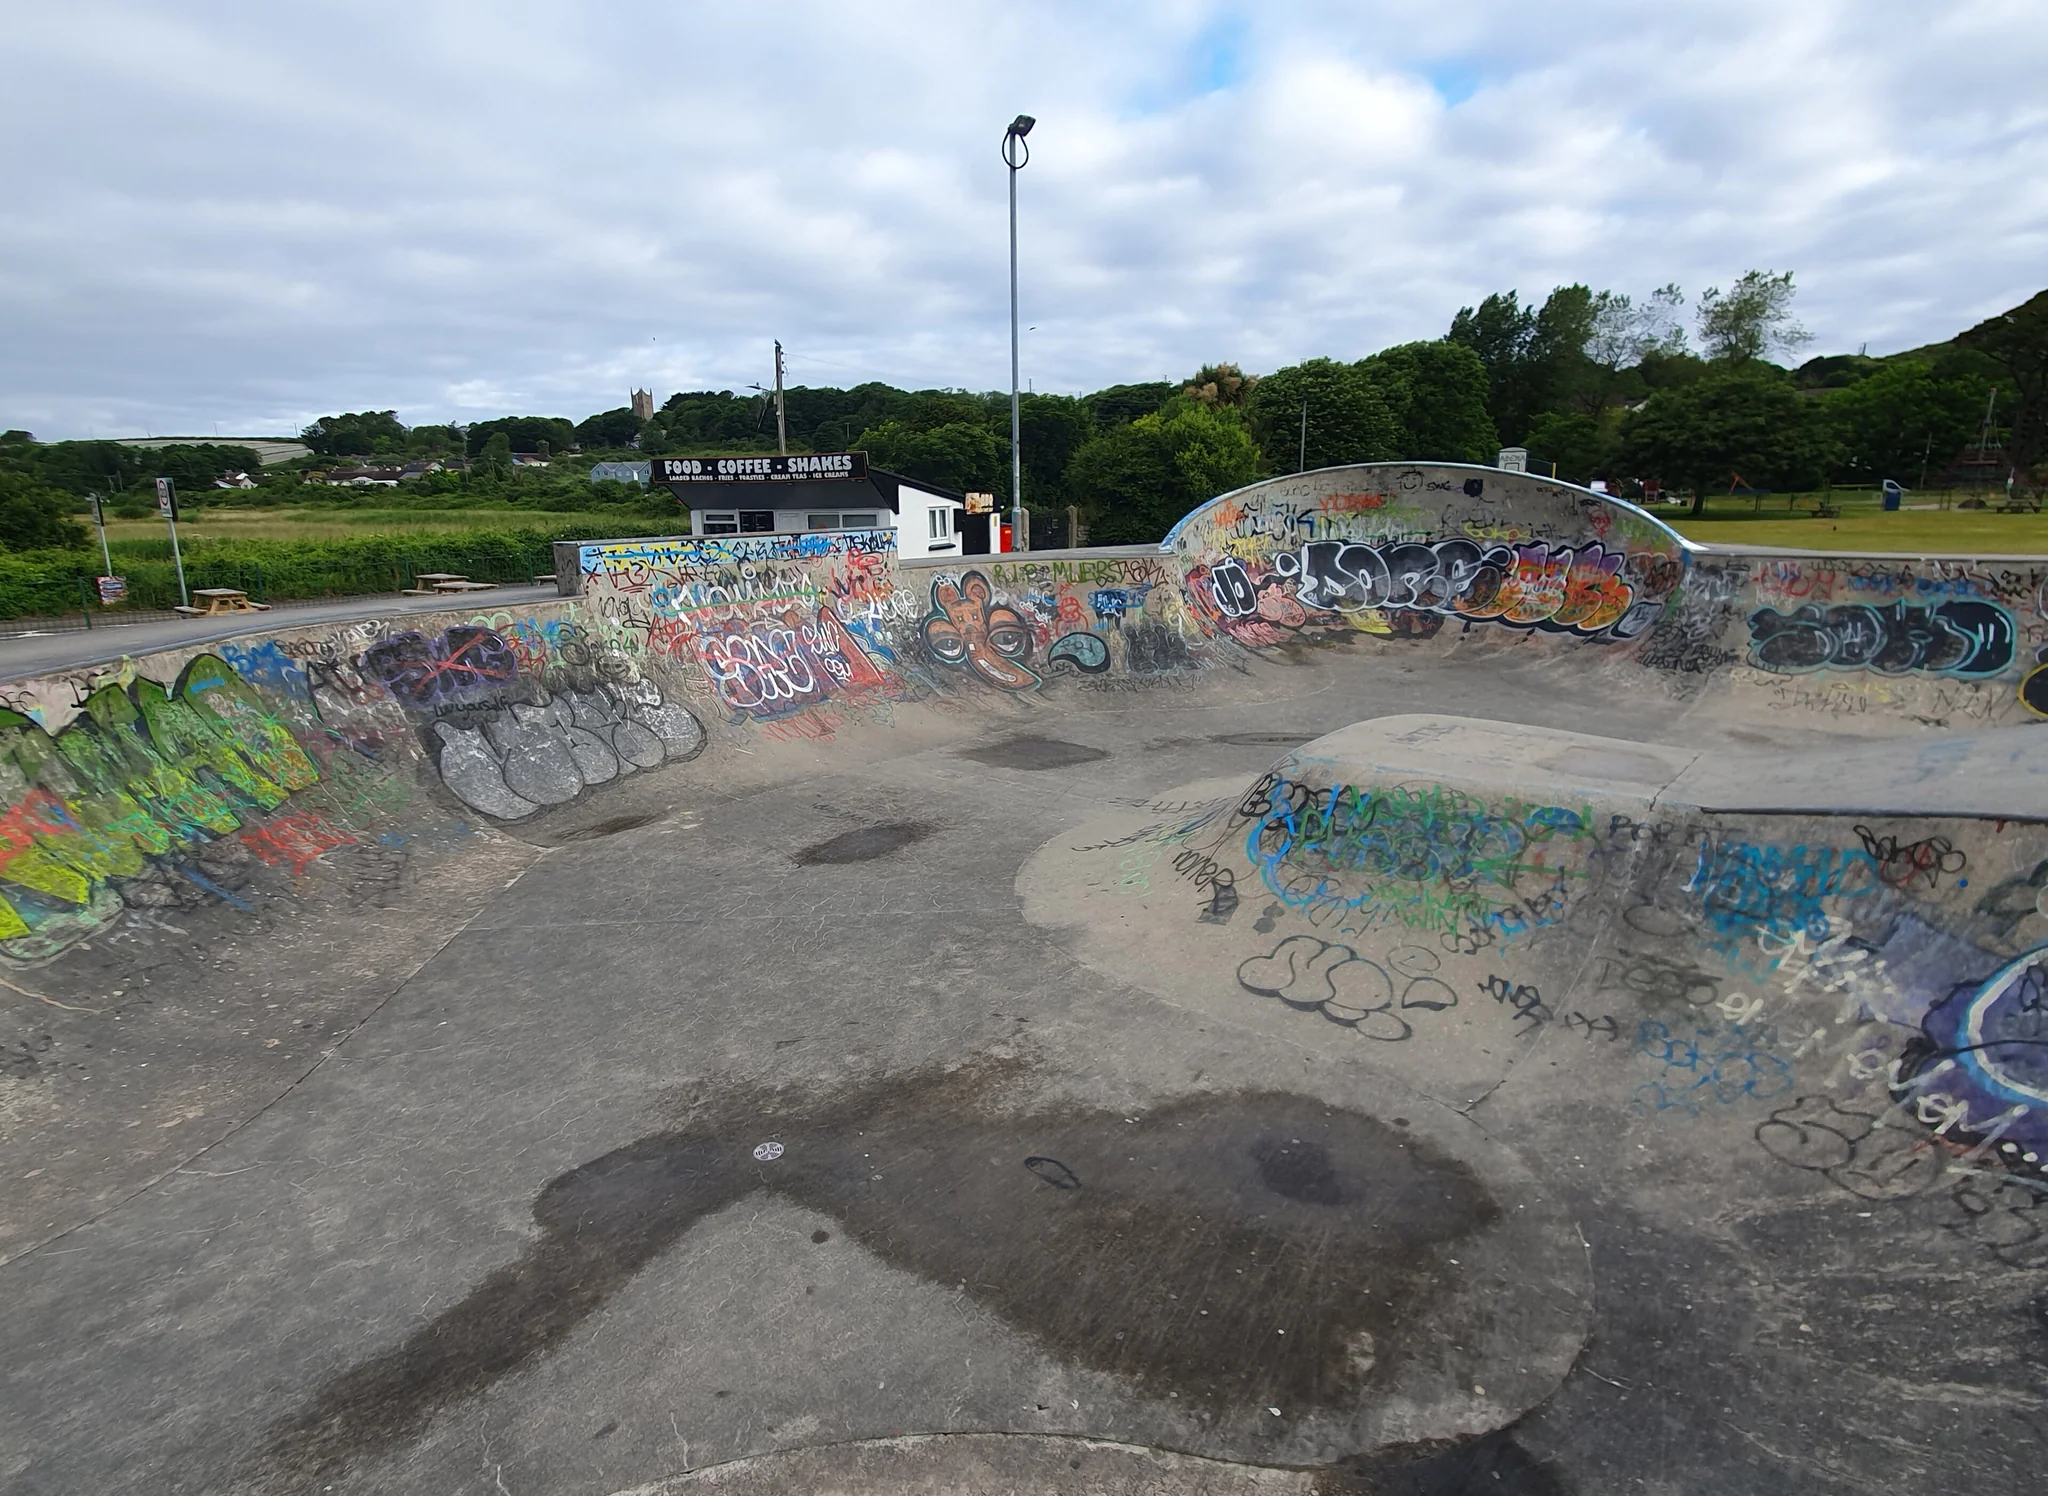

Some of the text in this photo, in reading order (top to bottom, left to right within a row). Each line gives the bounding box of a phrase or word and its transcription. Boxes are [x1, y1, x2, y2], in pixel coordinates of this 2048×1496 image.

[664, 455, 853, 474] FOOD COFFEE SHAKES
